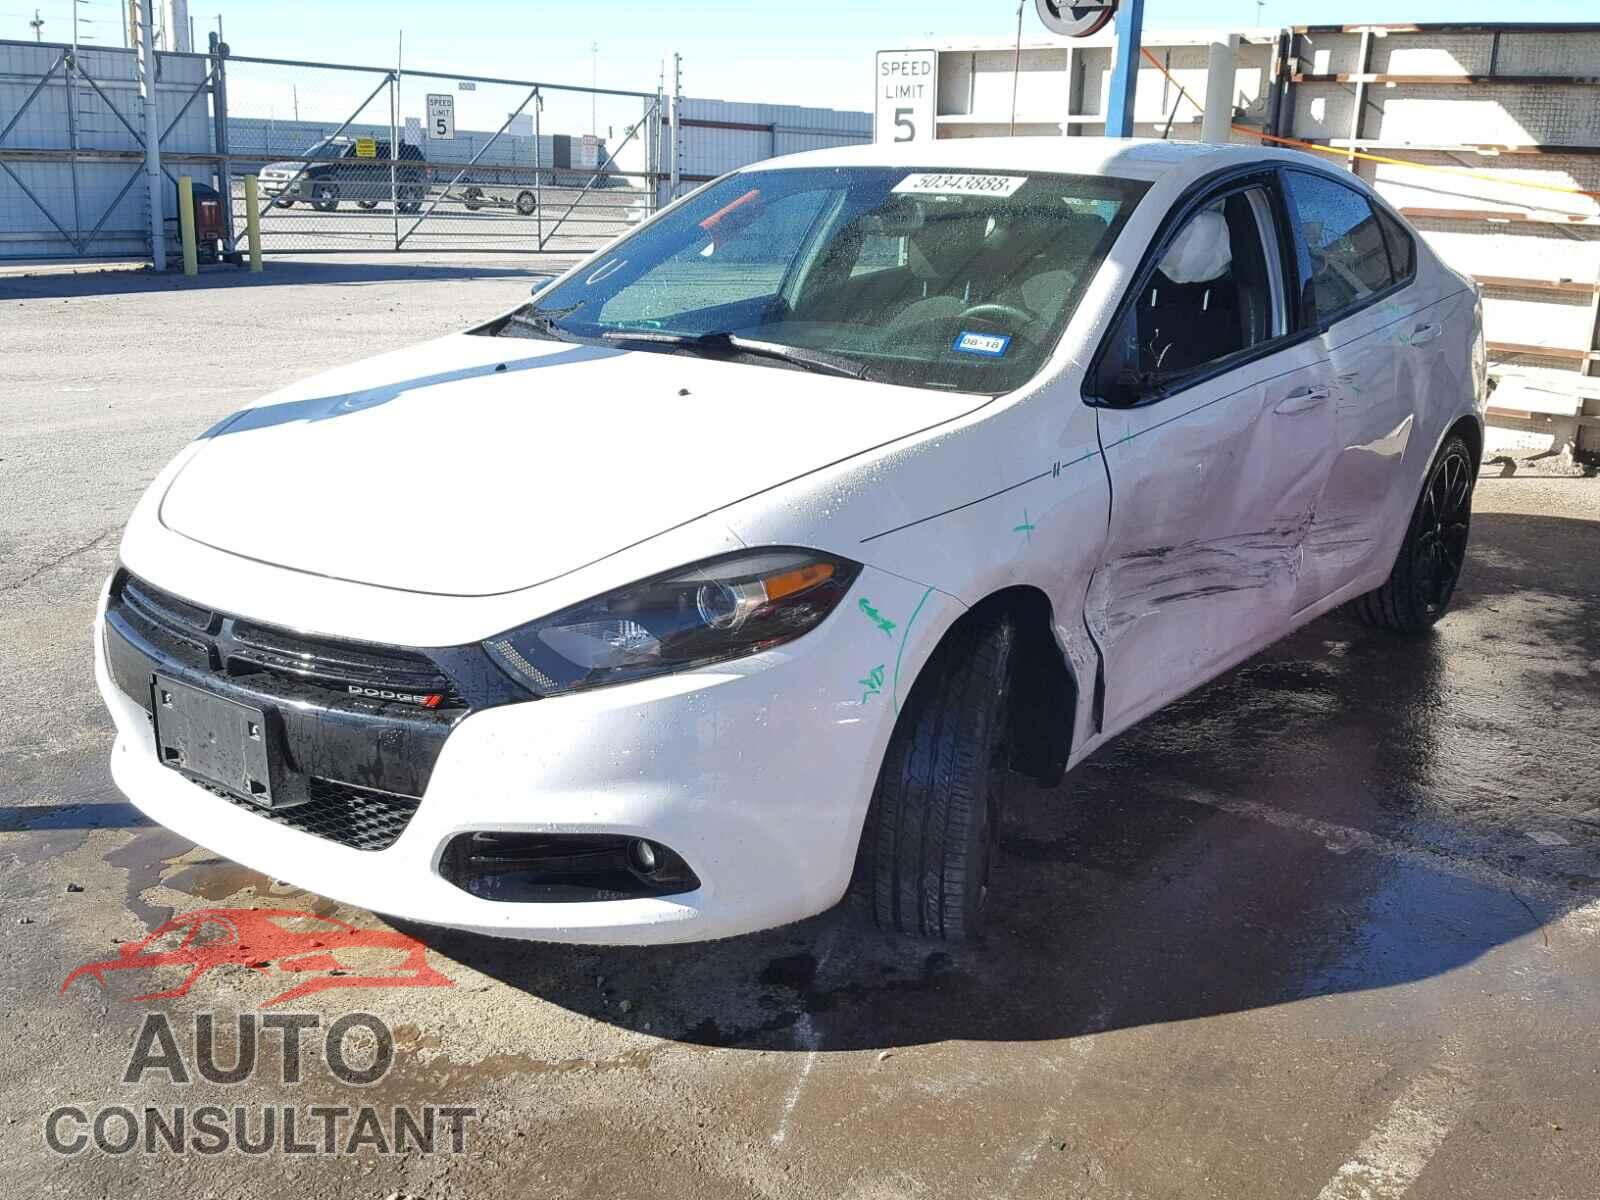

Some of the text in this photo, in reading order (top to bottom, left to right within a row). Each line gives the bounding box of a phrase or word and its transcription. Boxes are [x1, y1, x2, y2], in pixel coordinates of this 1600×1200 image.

[881, 61, 931, 76] SPEED
[886, 84, 924, 99] LIMIT
[430, 99, 452, 107] SPEED
[432, 109, 451, 117] LIMIT
[437, 118, 447, 135] 5
[894, 107, 916, 143] 5
[962, 337, 1000, 349] 08-18
[348, 685, 429, 703] DODGE
